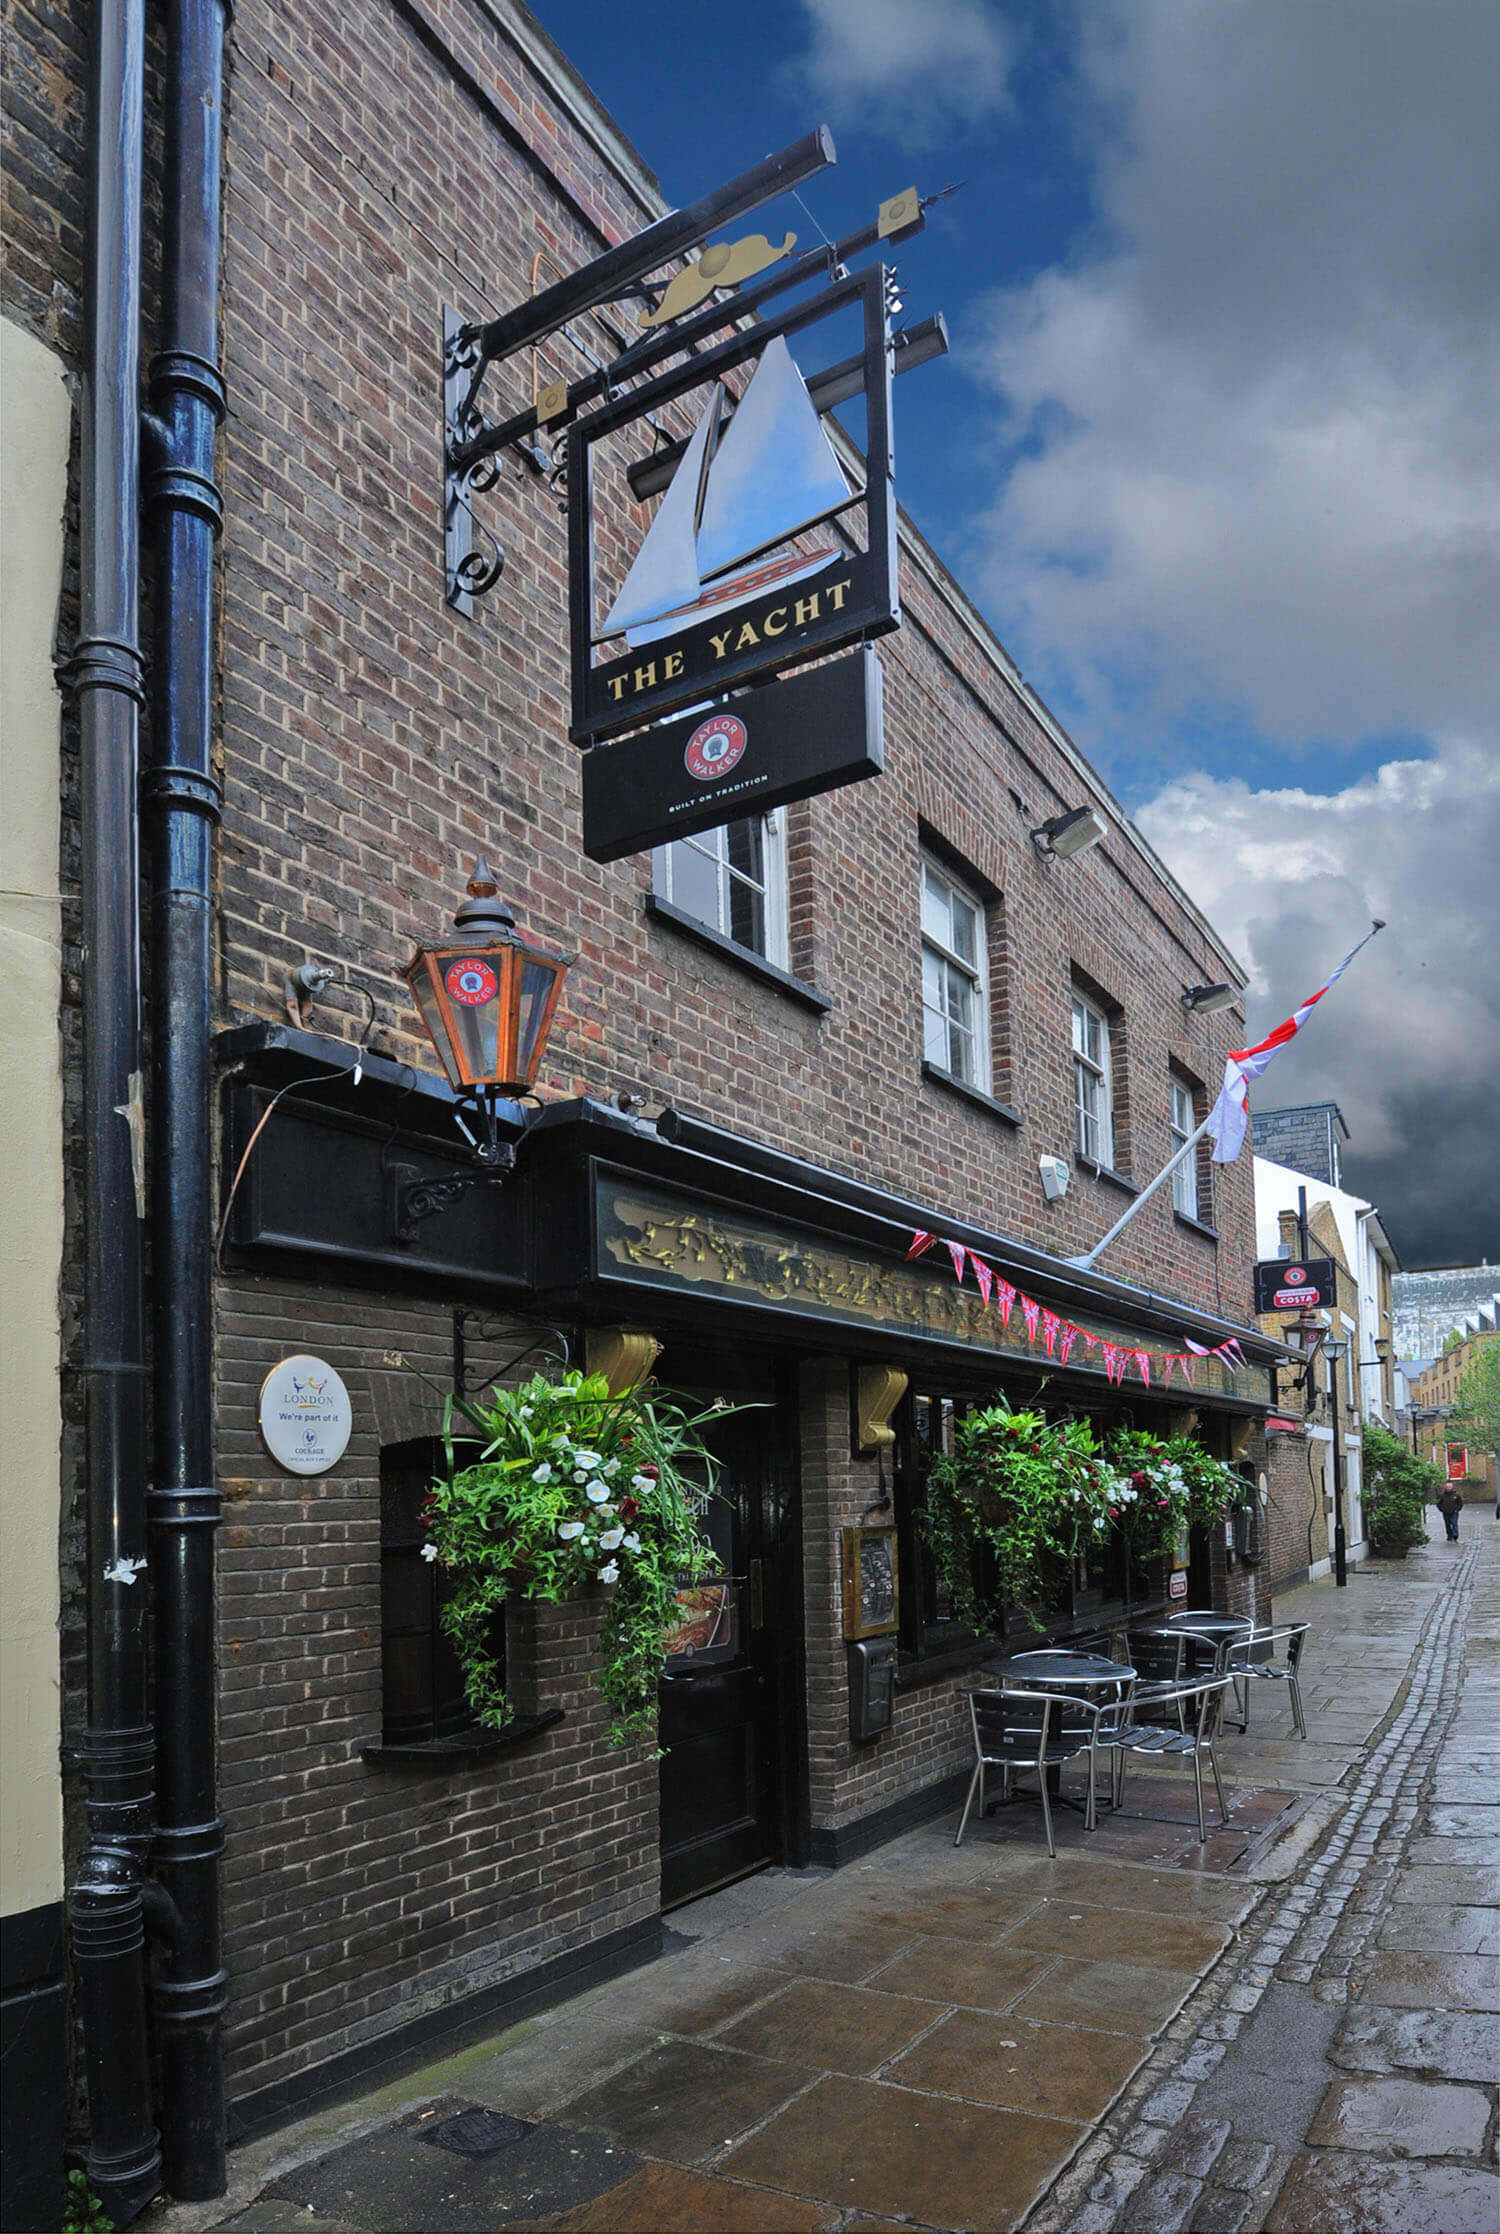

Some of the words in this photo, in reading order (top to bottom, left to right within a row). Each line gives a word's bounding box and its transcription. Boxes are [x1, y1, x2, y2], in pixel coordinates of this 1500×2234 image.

[607, 651, 684, 701] THE
[708, 578, 853, 659] YACHT
[692, 720, 738, 747] TAYLOR
[693, 747, 740, 775] WALKER
[668, 799, 695, 813] BUILT
[698, 793, 712, 803] ON
[715, 774, 768, 797] TRADITION
[450, 962, 489, 977] TAYLOR
[454, 986, 491, 1003] WALKER
[1280, 1296, 1312, 1304] COSTA
[284, 1394, 333, 1405] LONDON
[279, 1412, 302, 1421] We're
[304, 1414, 321, 1422] part
[333, 1414, 339, 1422] it
